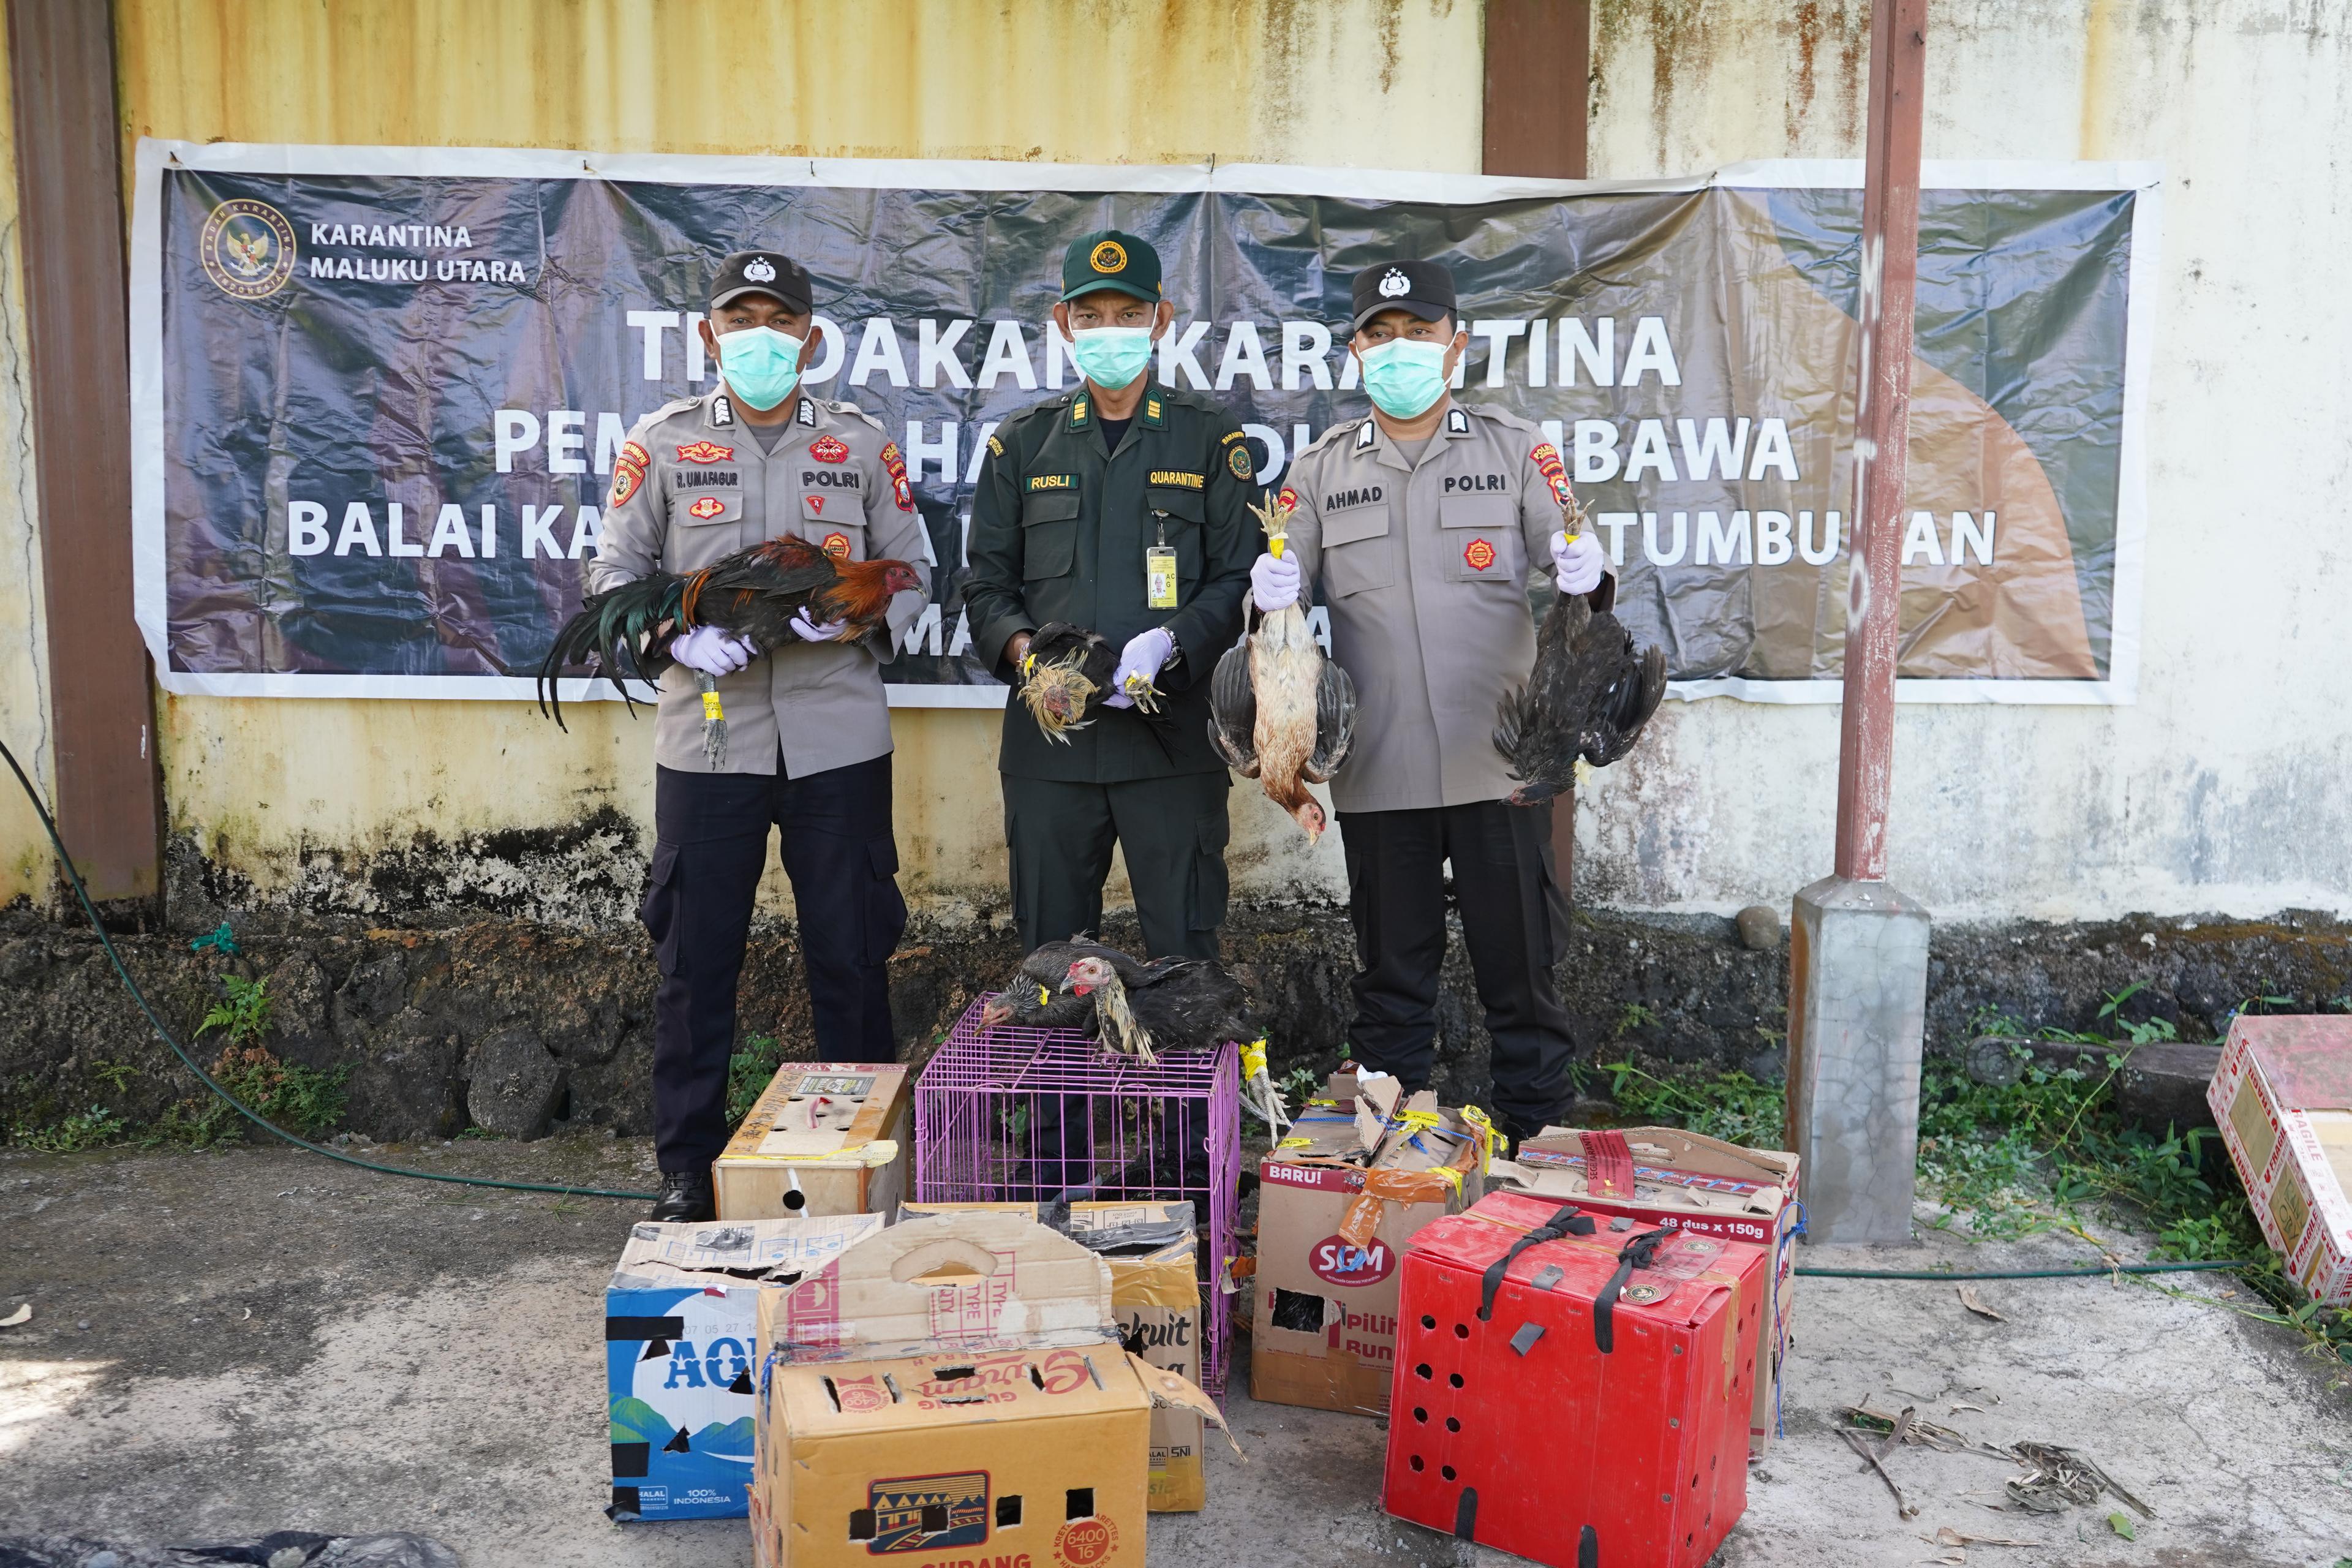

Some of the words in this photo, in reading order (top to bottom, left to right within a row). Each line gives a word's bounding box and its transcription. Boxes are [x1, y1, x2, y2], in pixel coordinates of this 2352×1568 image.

[205, 210, 227, 251] BADAN
[231, 203, 292, 252] KARANTINA
[311, 224, 472, 247] KARANTINA
[310, 257, 429, 281] MALUKU
[437, 260, 526, 282] UTARA
[216, 273, 282, 295] INDONESIA
[627, 310, 1088, 390] TIDAKAN
[1158, 317, 1681, 391] KARTINA
[802, 471, 860, 489] POLRI
[1031, 475, 1069, 490] RUSLI
[1150, 470, 1204, 488] QUARANTINE
[1444, 474, 1506, 492] POLRI
[1326, 486, 1382, 511] AHMAD
[288, 501, 495, 559] BALAI
[1597, 511, 1997, 567] TUMBUAN
[1269, 1166, 1322, 1185] BARU!
[1659, 1217, 1678, 1227] 48
[1682, 1219, 1709, 1231] dus
[1713, 1223, 1722, 1232] x
[1727, 1223, 1764, 1239] 150g
[2296, 1208, 2319, 1264] FRAGILE
[1319, 1244, 1384, 1272] SGM
[2299, 1250, 2310, 1274] HANDLE
[939, 1289, 954, 1314] QTY
[966, 1283, 981, 1320] TYPE
[704, 1324, 718, 1334] 05
[725, 1323, 739, 1333] 27
[1118, 1311, 1192, 1349] skuit
[912, 1352, 987, 1366] MERAH
[1346, 1339, 1396, 1361] Bun
[1170, 1446, 1191, 1458] SNI
[674, 1496, 731, 1505] INDONESIA
[1054, 1523, 1073, 1547] KRETE
[1095, 1512, 1118, 1541] ARETTES
[1067, 1528, 1106, 1545] 6400
[1077, 1545, 1095, 1559] 16
